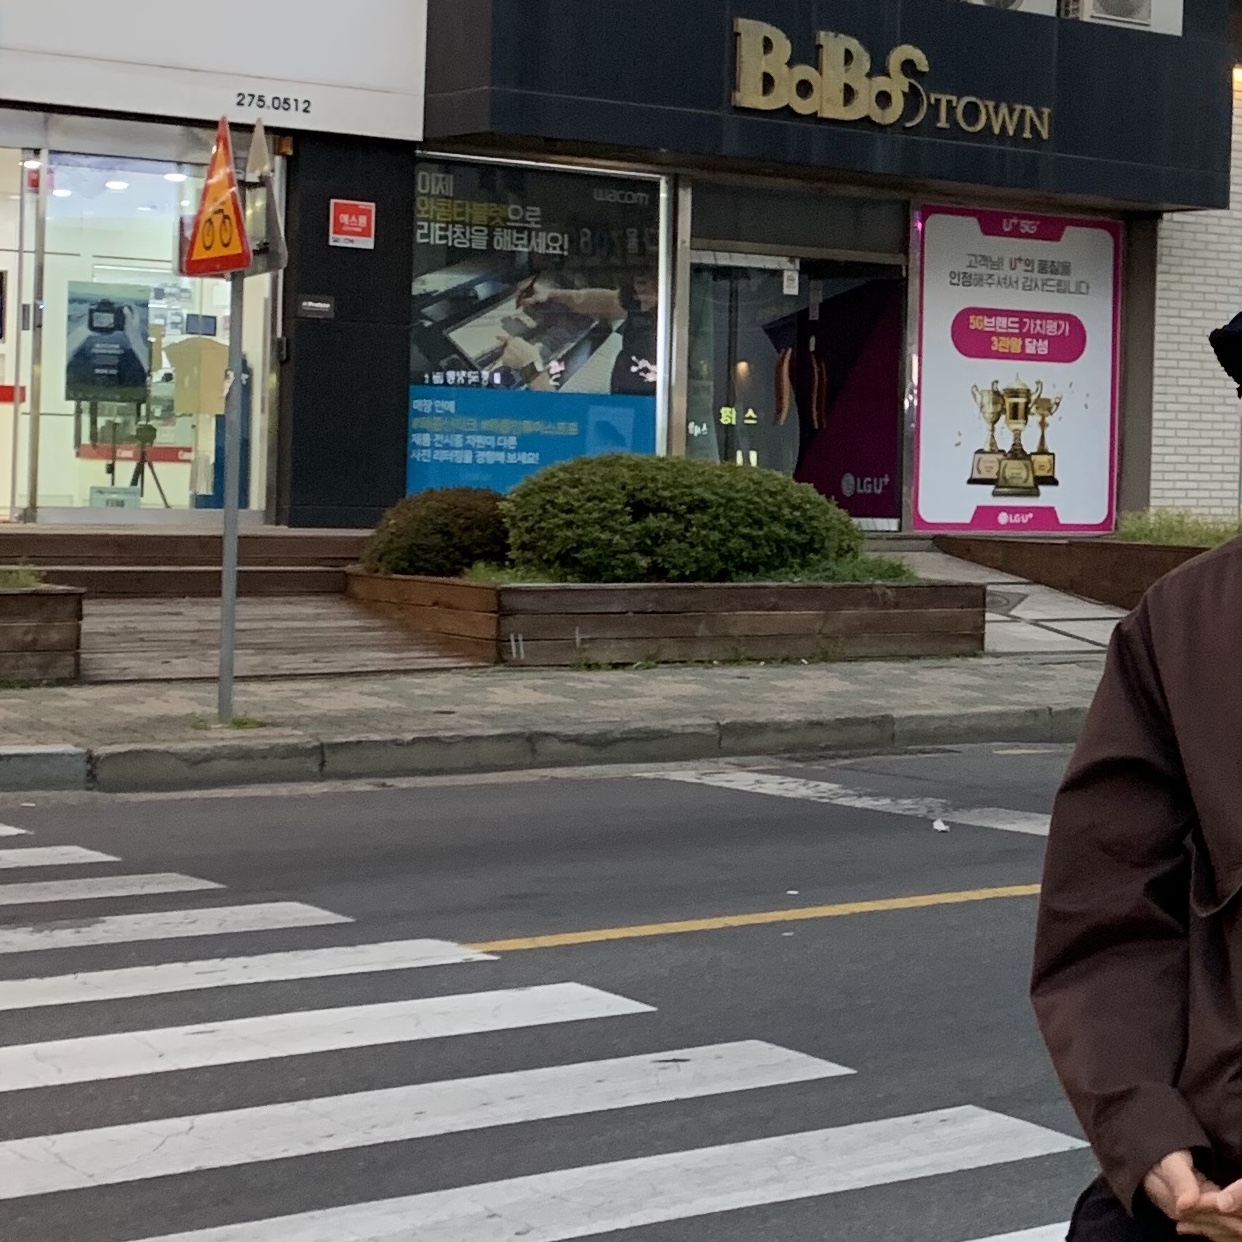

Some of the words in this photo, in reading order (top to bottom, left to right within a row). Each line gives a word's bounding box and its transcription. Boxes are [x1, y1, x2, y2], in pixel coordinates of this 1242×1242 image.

[236, 92, 311, 113] 275.0512
[930, 93, 1051, 140] TOWN
[417, 171, 454, 197] 이제
[593, 187, 649, 204] wacom
[415, 222, 488, 250] 리터칭을
[493, 227, 569, 256] 해보세요!
[949, 270, 1019, 291] 인정해주셔서
[1022, 277, 1090, 295] 감사드립니다
[1022, 318, 1070, 336] 가치평가
[1025, 338, 1049, 355] 달성
